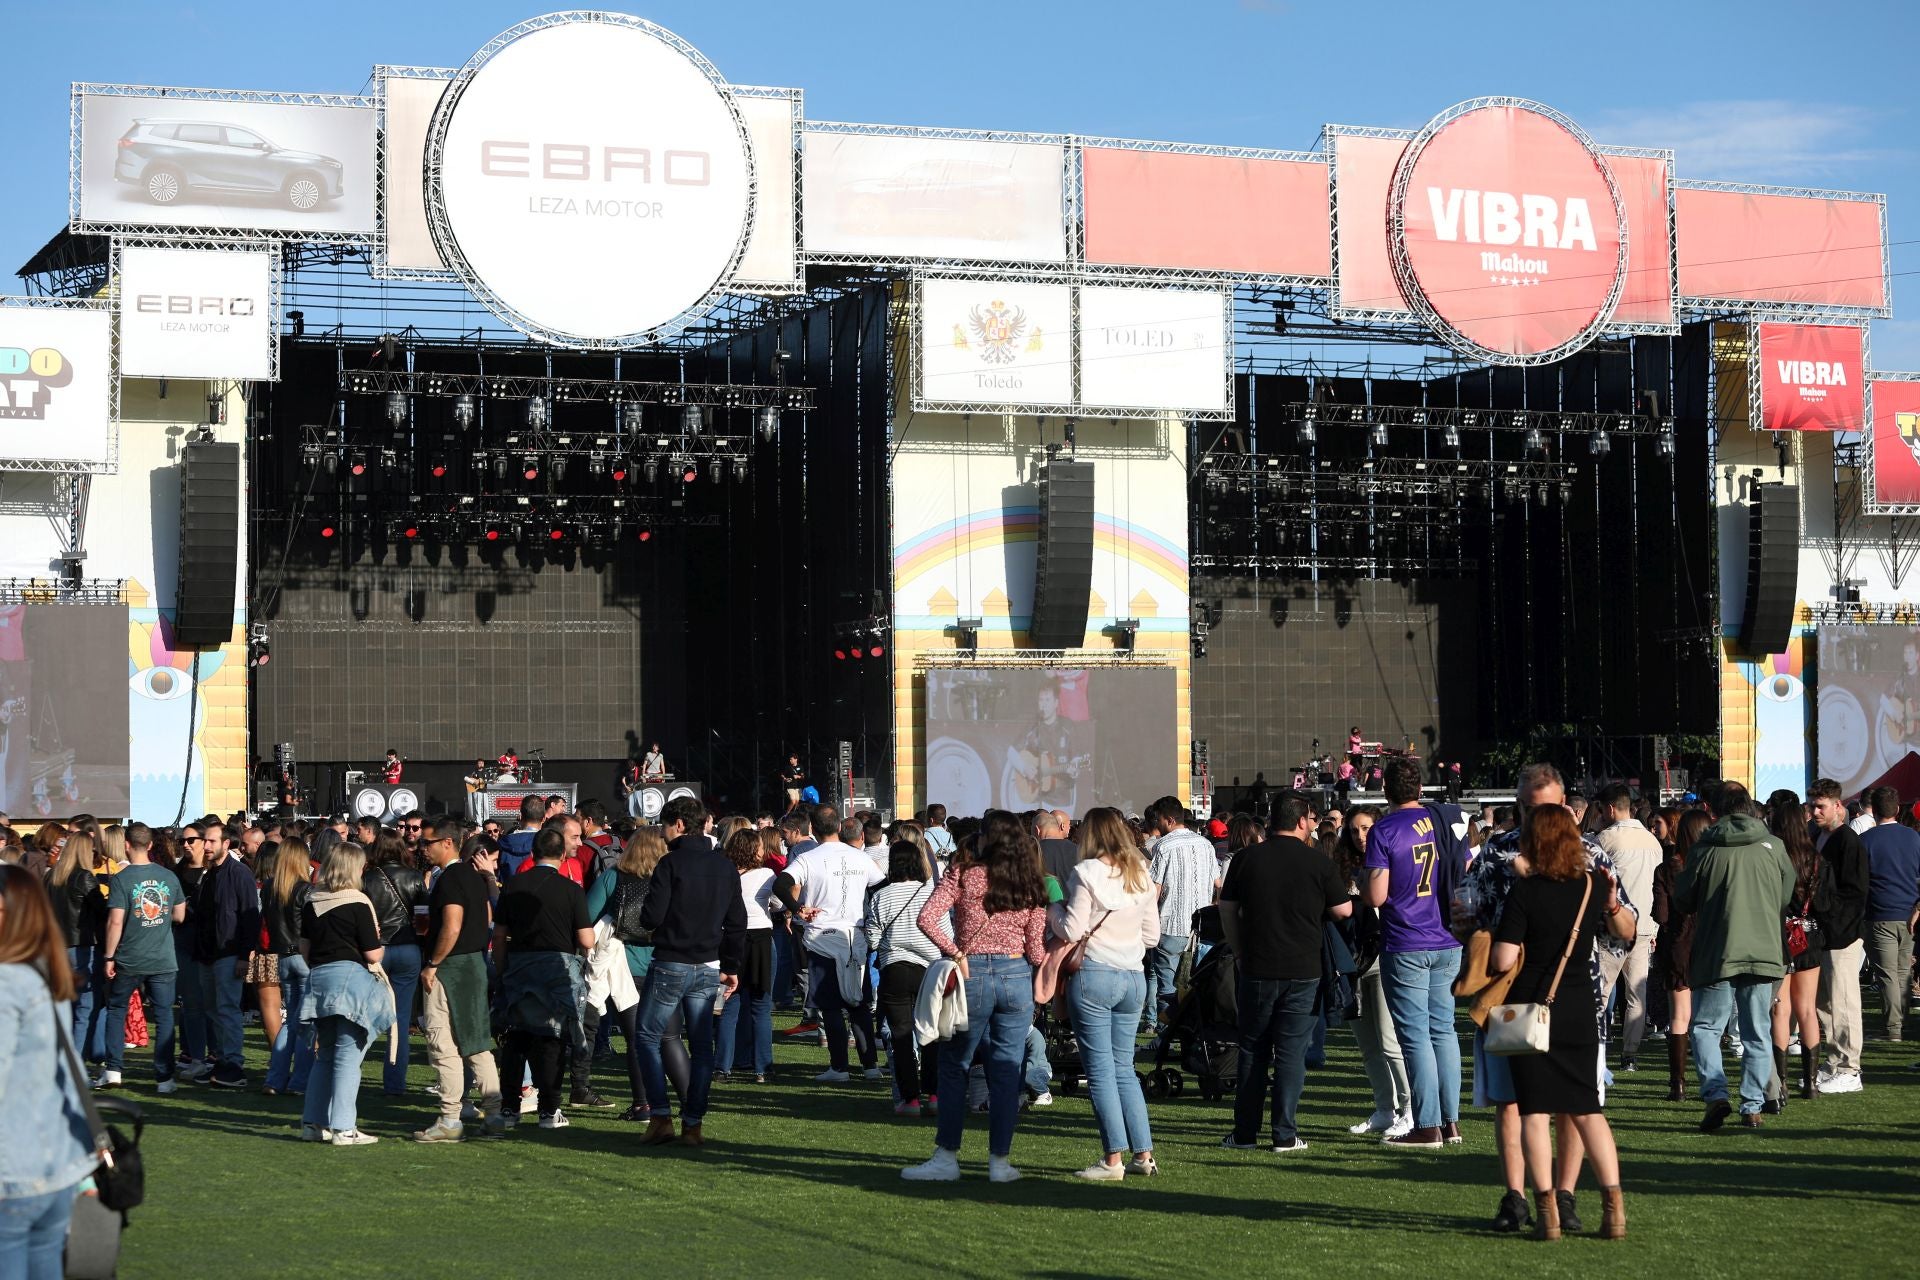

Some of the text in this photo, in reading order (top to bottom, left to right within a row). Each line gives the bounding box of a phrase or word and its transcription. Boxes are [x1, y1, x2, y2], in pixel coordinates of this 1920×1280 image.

[481, 140, 711, 187] EBRO
[529, 196, 664, 219] LEZA MOTOR
[1427, 187, 1598, 251] VIBRA
[1480, 251, 1548, 275] Mahou
[137, 294, 254, 316] EBRO
[160, 321, 230, 333] LEZA MOTOR
[974, 373, 1023, 389] Toledo
[1777, 359, 1847, 386] VIBRA
[1412, 842, 1439, 897] 7
